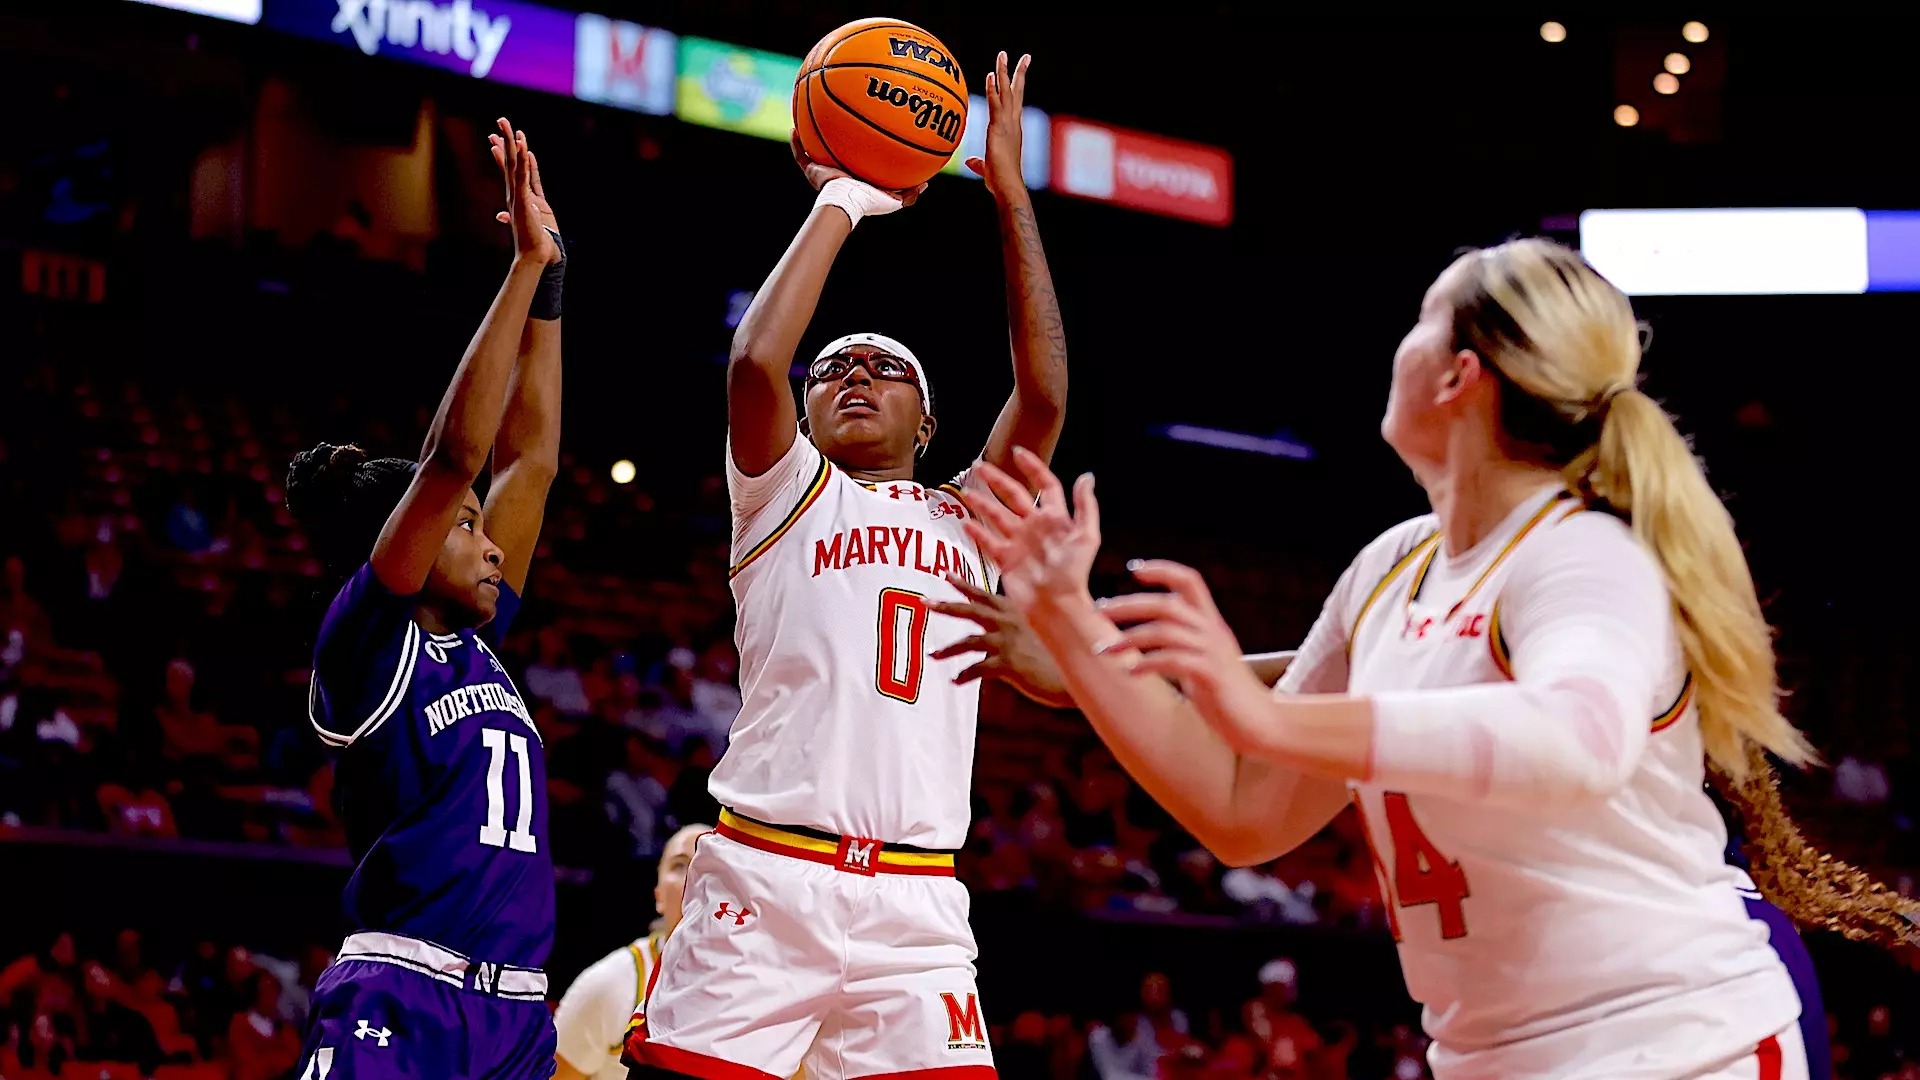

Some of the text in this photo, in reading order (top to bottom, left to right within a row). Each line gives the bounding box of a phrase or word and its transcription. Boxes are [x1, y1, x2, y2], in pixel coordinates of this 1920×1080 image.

[888, 37, 961, 85] NCAA
[867, 77, 961, 143] Wilson
[912, 85, 943, 102] EVO NXT
[876, 587, 929, 704] 0
[480, 728, 537, 854] 11
[845, 840, 875, 868] M
[939, 992, 985, 1043] M
